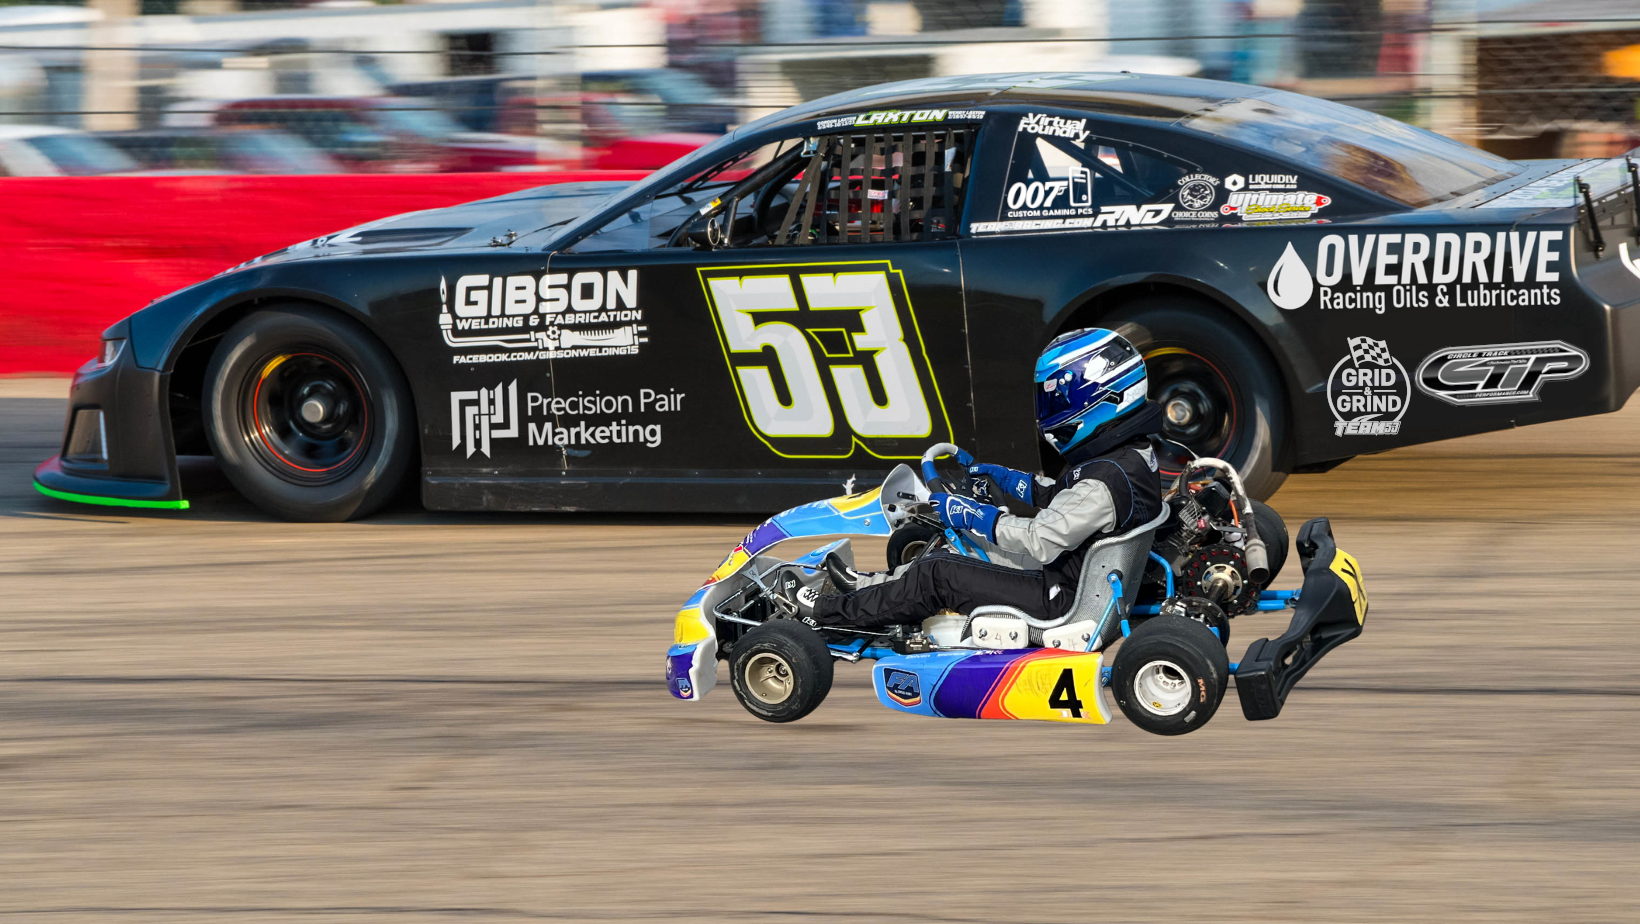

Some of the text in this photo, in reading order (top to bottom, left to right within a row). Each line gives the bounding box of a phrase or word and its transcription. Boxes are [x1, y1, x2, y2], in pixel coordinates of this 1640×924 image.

[854, 109, 950, 126] LAXTON
[1028, 112, 1087, 131] Virtual
[1018, 119, 1090, 143] Foundry
[1007, 181, 1068, 210] 007
[1007, 210, 1041, 218] CUSTOM
[1042, 208, 1076, 217] GAMING
[1316, 231, 1563, 286] OVERDRIVE
[455, 269, 638, 317] GIBSON
[1320, 282, 1561, 314] Racing Oils & Lubricants
[456, 310, 642, 330] WELDING & FABRICATION
[453, 345, 639, 364] FACEBOOK.COM/GIBSONWELDING15
[706, 270, 933, 438] 53
[1447, 350, 1509, 360] CIRCLE TRACK
[1341, 368, 1396, 387] GRID
[527, 388, 686, 416] Precision Pair
[1364, 386, 1372, 396] &
[1336, 395, 1402, 412] GRIND
[528, 420, 662, 448] Marketing
[1048, 668, 1083, 718] 4
